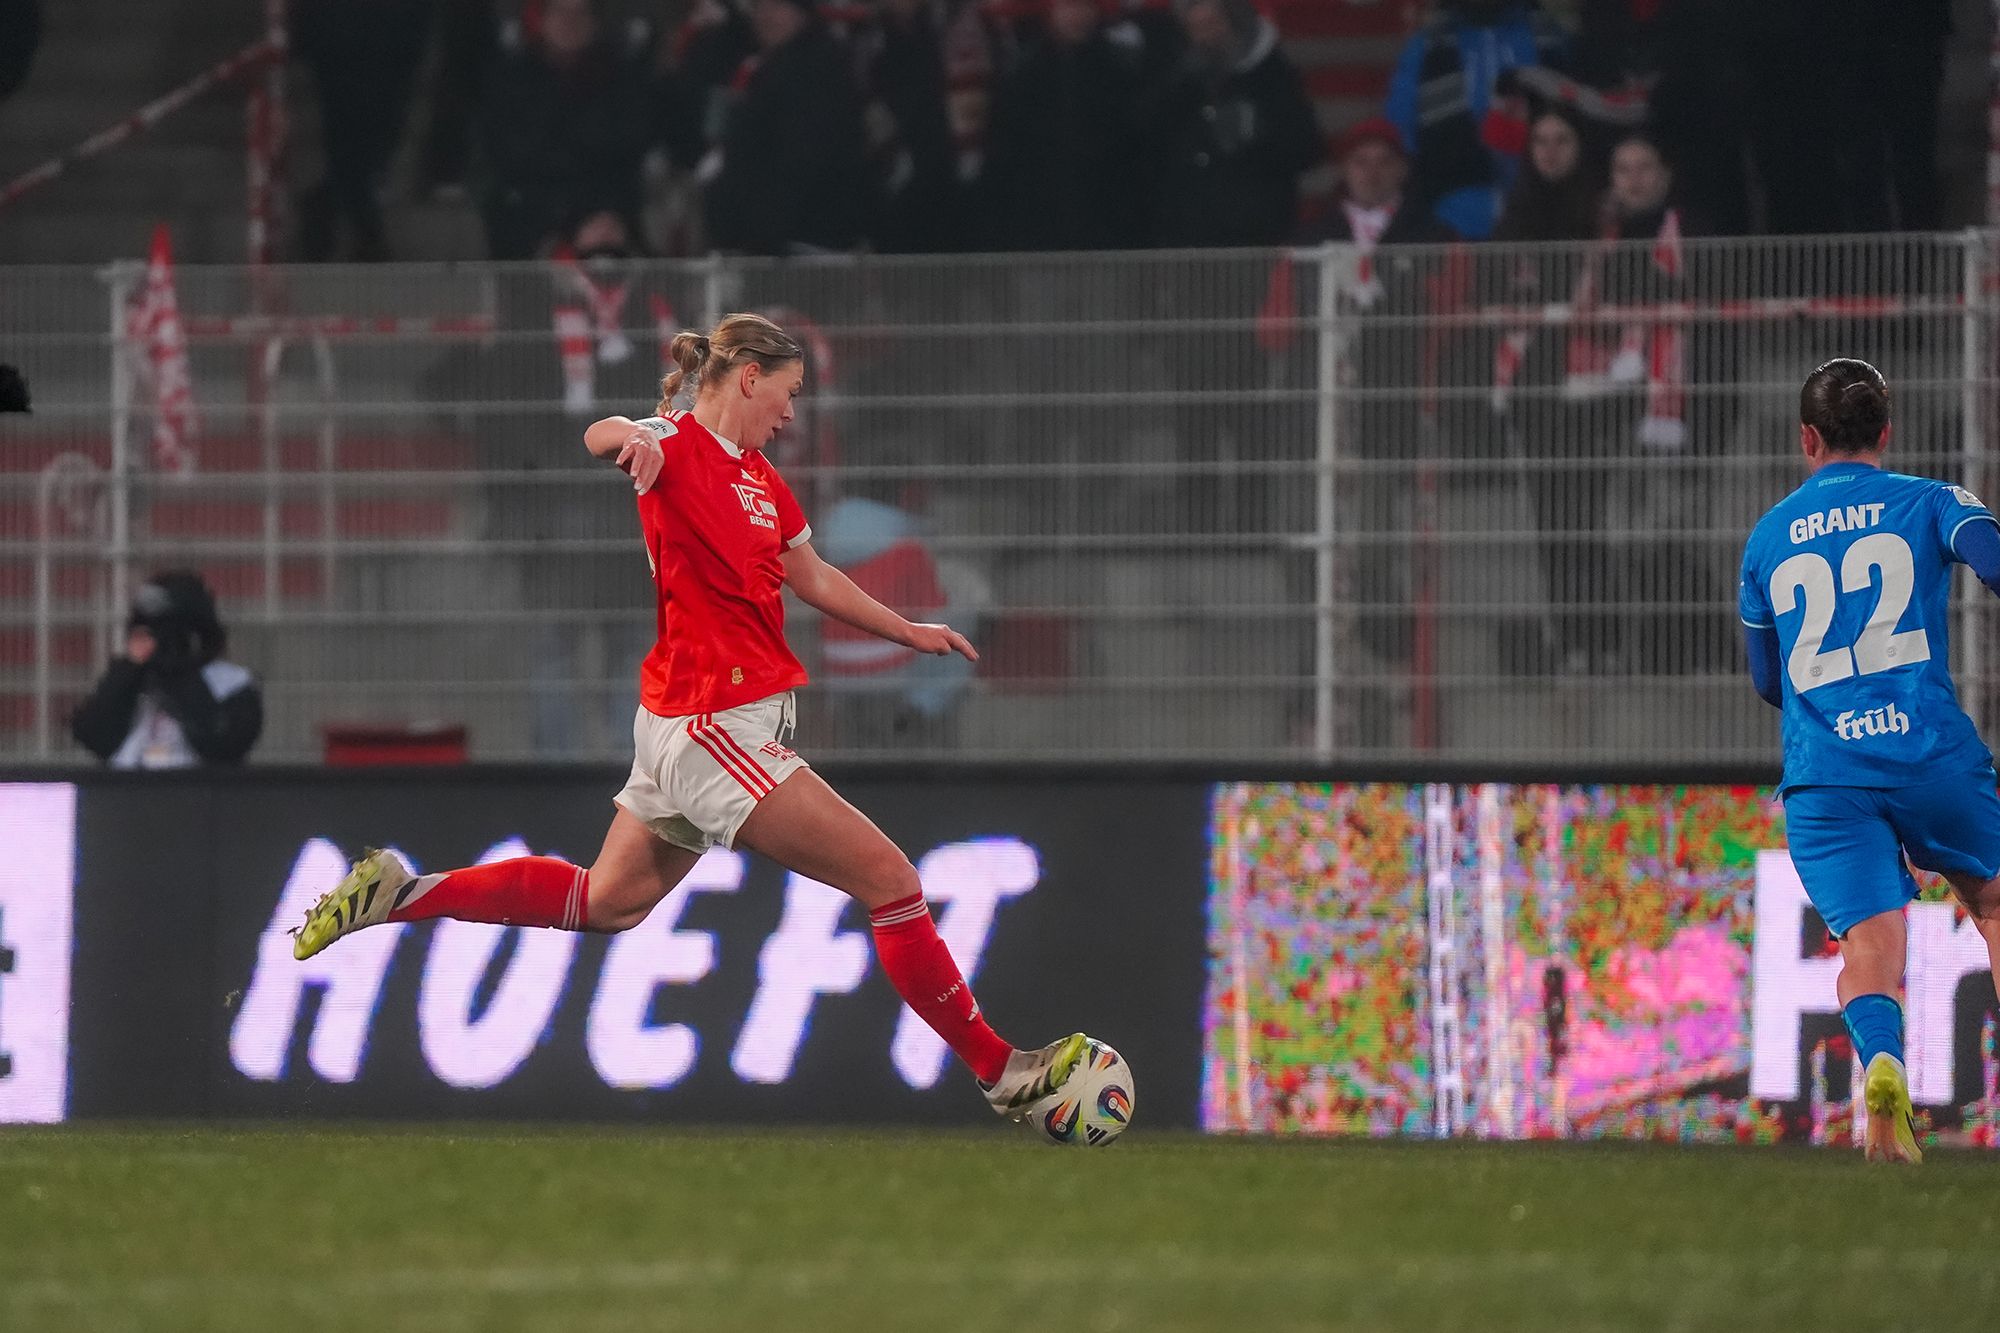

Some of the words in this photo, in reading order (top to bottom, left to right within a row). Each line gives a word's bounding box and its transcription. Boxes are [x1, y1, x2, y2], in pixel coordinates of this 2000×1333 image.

[749, 515, 775, 530] BERLIN
[1789, 502, 1885, 545] GRANT
[1769, 532, 1931, 695] 22
